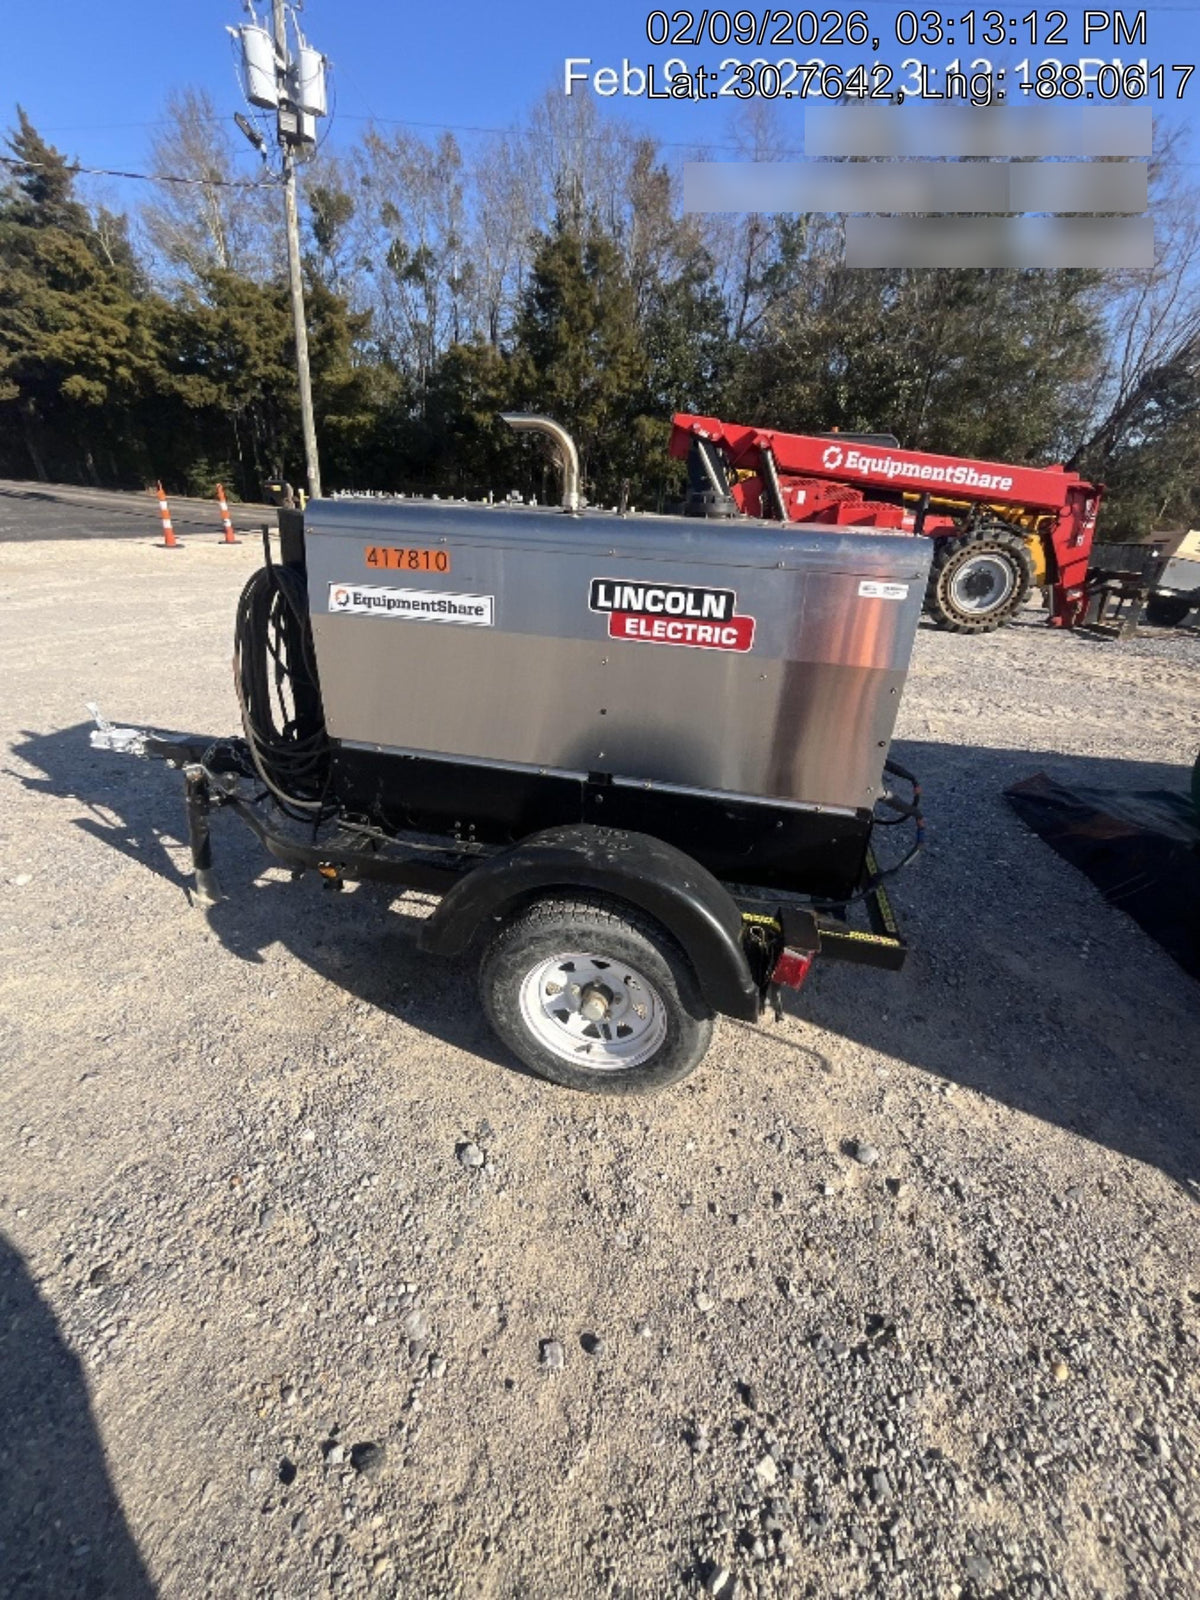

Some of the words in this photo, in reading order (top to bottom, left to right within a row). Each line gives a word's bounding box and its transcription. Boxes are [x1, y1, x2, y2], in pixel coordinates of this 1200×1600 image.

[844, 450, 1014, 492] EquipmentShare
[366, 547, 448, 572] 417810
[351, 590, 486, 617] EquipmentShare
[596, 583, 727, 620] LINCOLN
[624, 616, 739, 646] ELECTRIC
